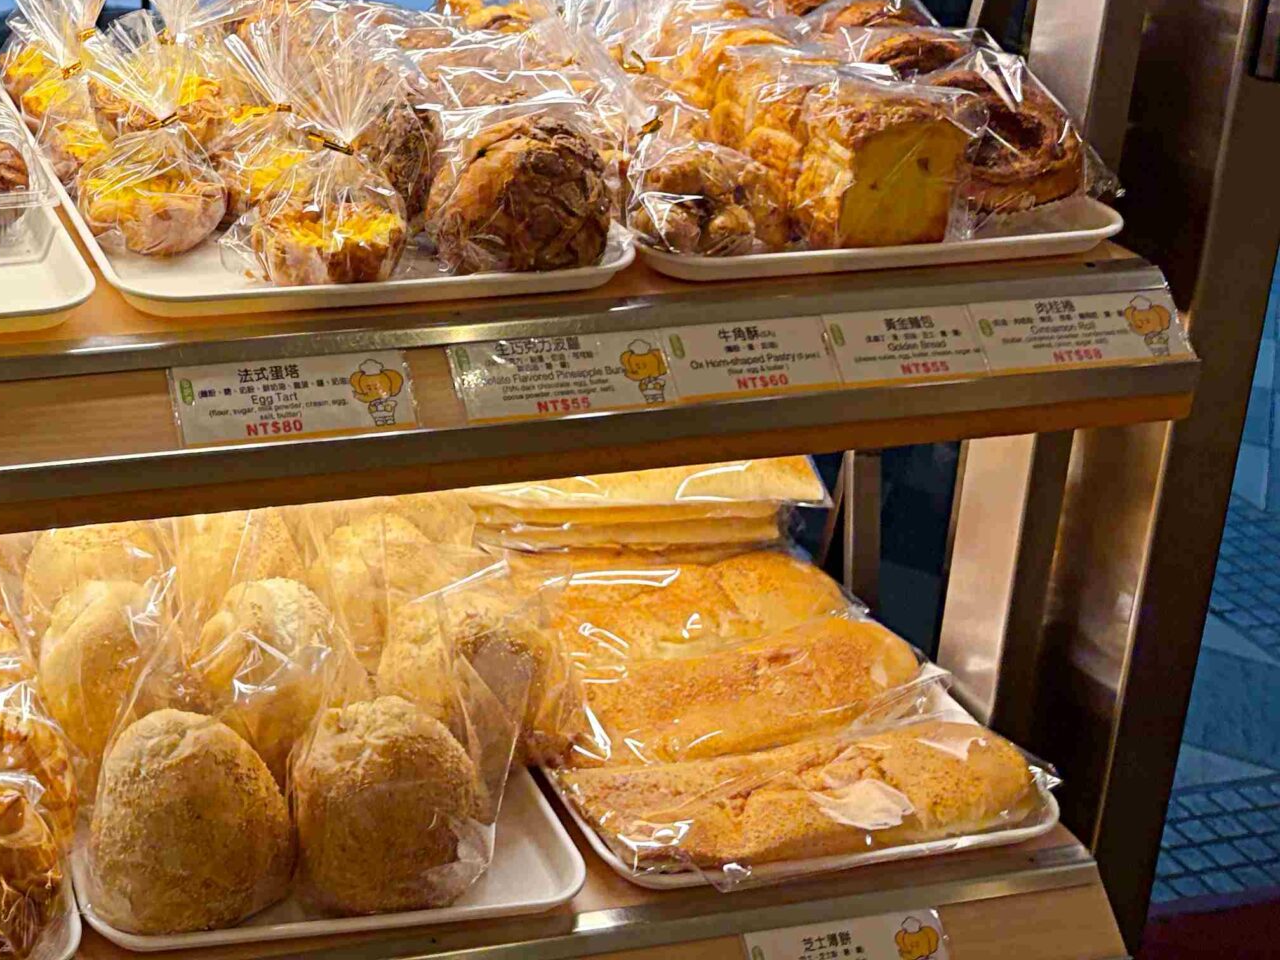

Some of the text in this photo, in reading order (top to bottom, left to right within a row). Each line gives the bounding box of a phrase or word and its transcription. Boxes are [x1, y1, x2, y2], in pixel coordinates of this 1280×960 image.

[237, 365, 300, 384] 法式蛋塔
[737, 373, 789, 389] NT$60
[251, 392, 298, 406] Egg Tart
[537, 397, 591, 413] NT$55
[246, 420, 303, 436] NT$80
